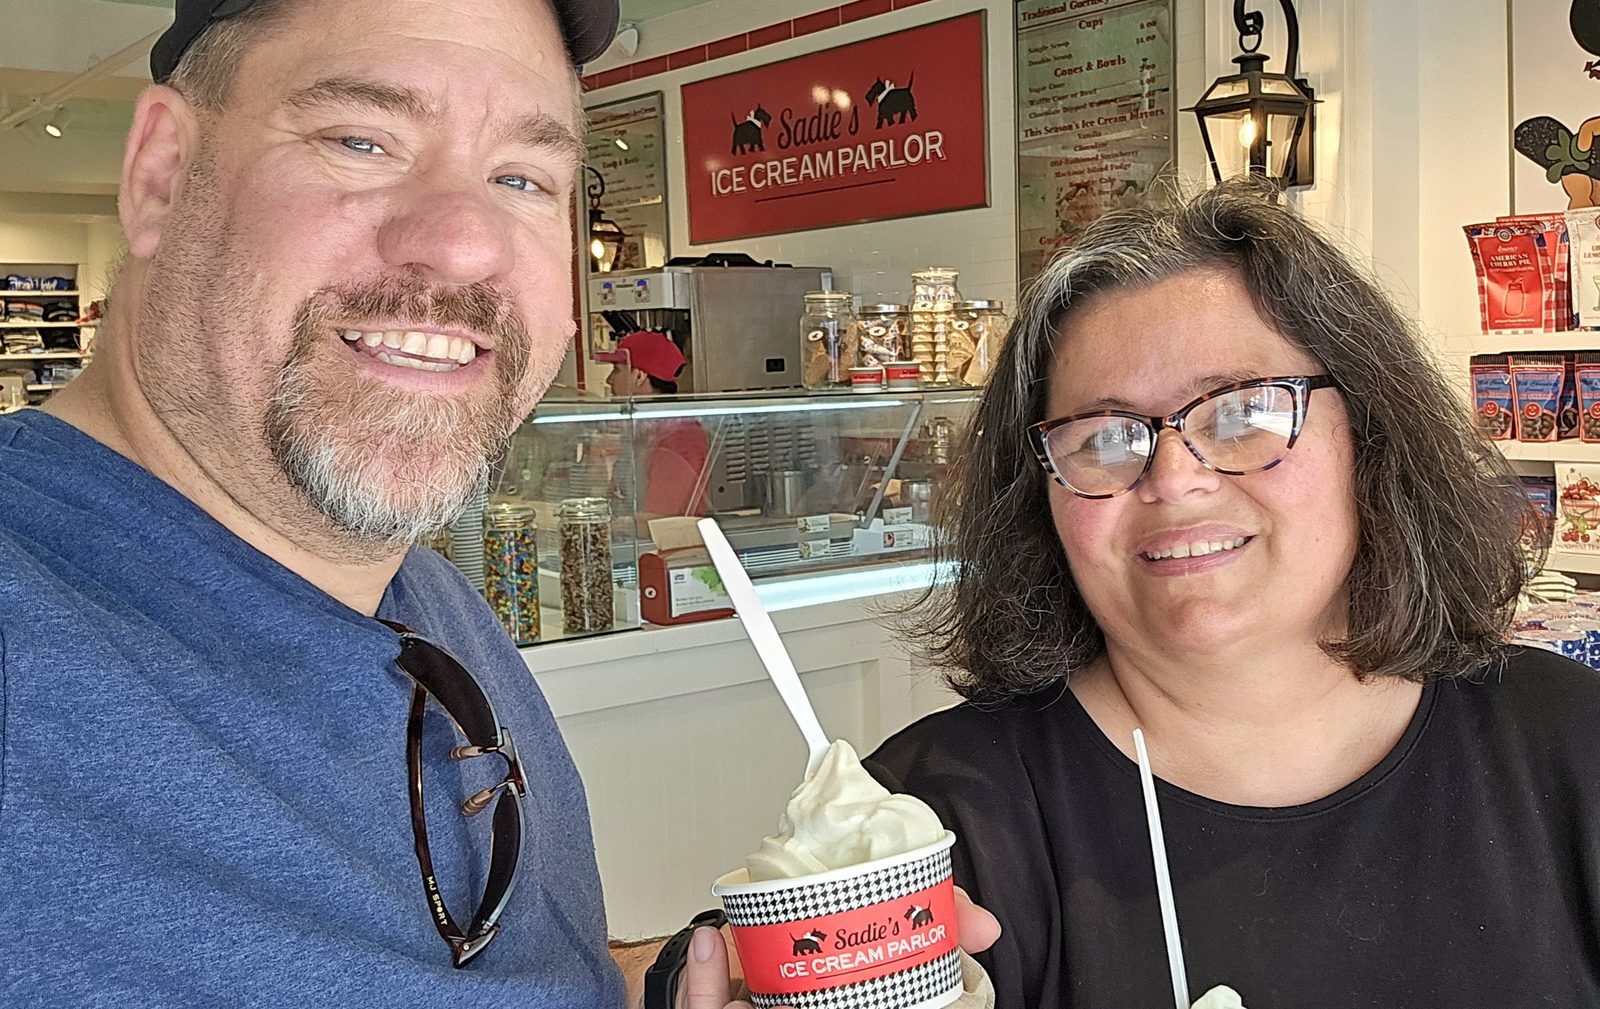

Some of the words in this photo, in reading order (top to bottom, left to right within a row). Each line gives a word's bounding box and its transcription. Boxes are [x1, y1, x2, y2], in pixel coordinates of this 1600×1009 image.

[1021, 2, 1067, 21] Traditional
[1070, 0, 1109, 10] Guern
[1078, 17, 1103, 30] Cups
[1054, 65, 1084, 78] Cones
[1085, 62, 1095, 71] &
[1097, 55, 1127, 70] Bowls
[777, 103, 860, 150] Sadies
[1023, 126, 1043, 138] This
[1044, 121, 1080, 134] Season's
[1081, 119, 1095, 129] Ice
[1097, 114, 1127, 126] Cream
[711, 166, 747, 196] ICE
[750, 150, 834, 190] CREAM
[838, 131, 946, 175] PARLOR
[1489, 260, 1518, 268] CHERRY
[1490, 253, 1529, 262] AMERICAN
[426, 875, 437, 891] MJ
[432, 893, 449, 926] SPORT
[834, 918, 901, 951] Sadie's
[778, 959, 808, 981] ICE
[812, 946, 885, 976] CREAM
[887, 924, 947, 960] PARLOR
